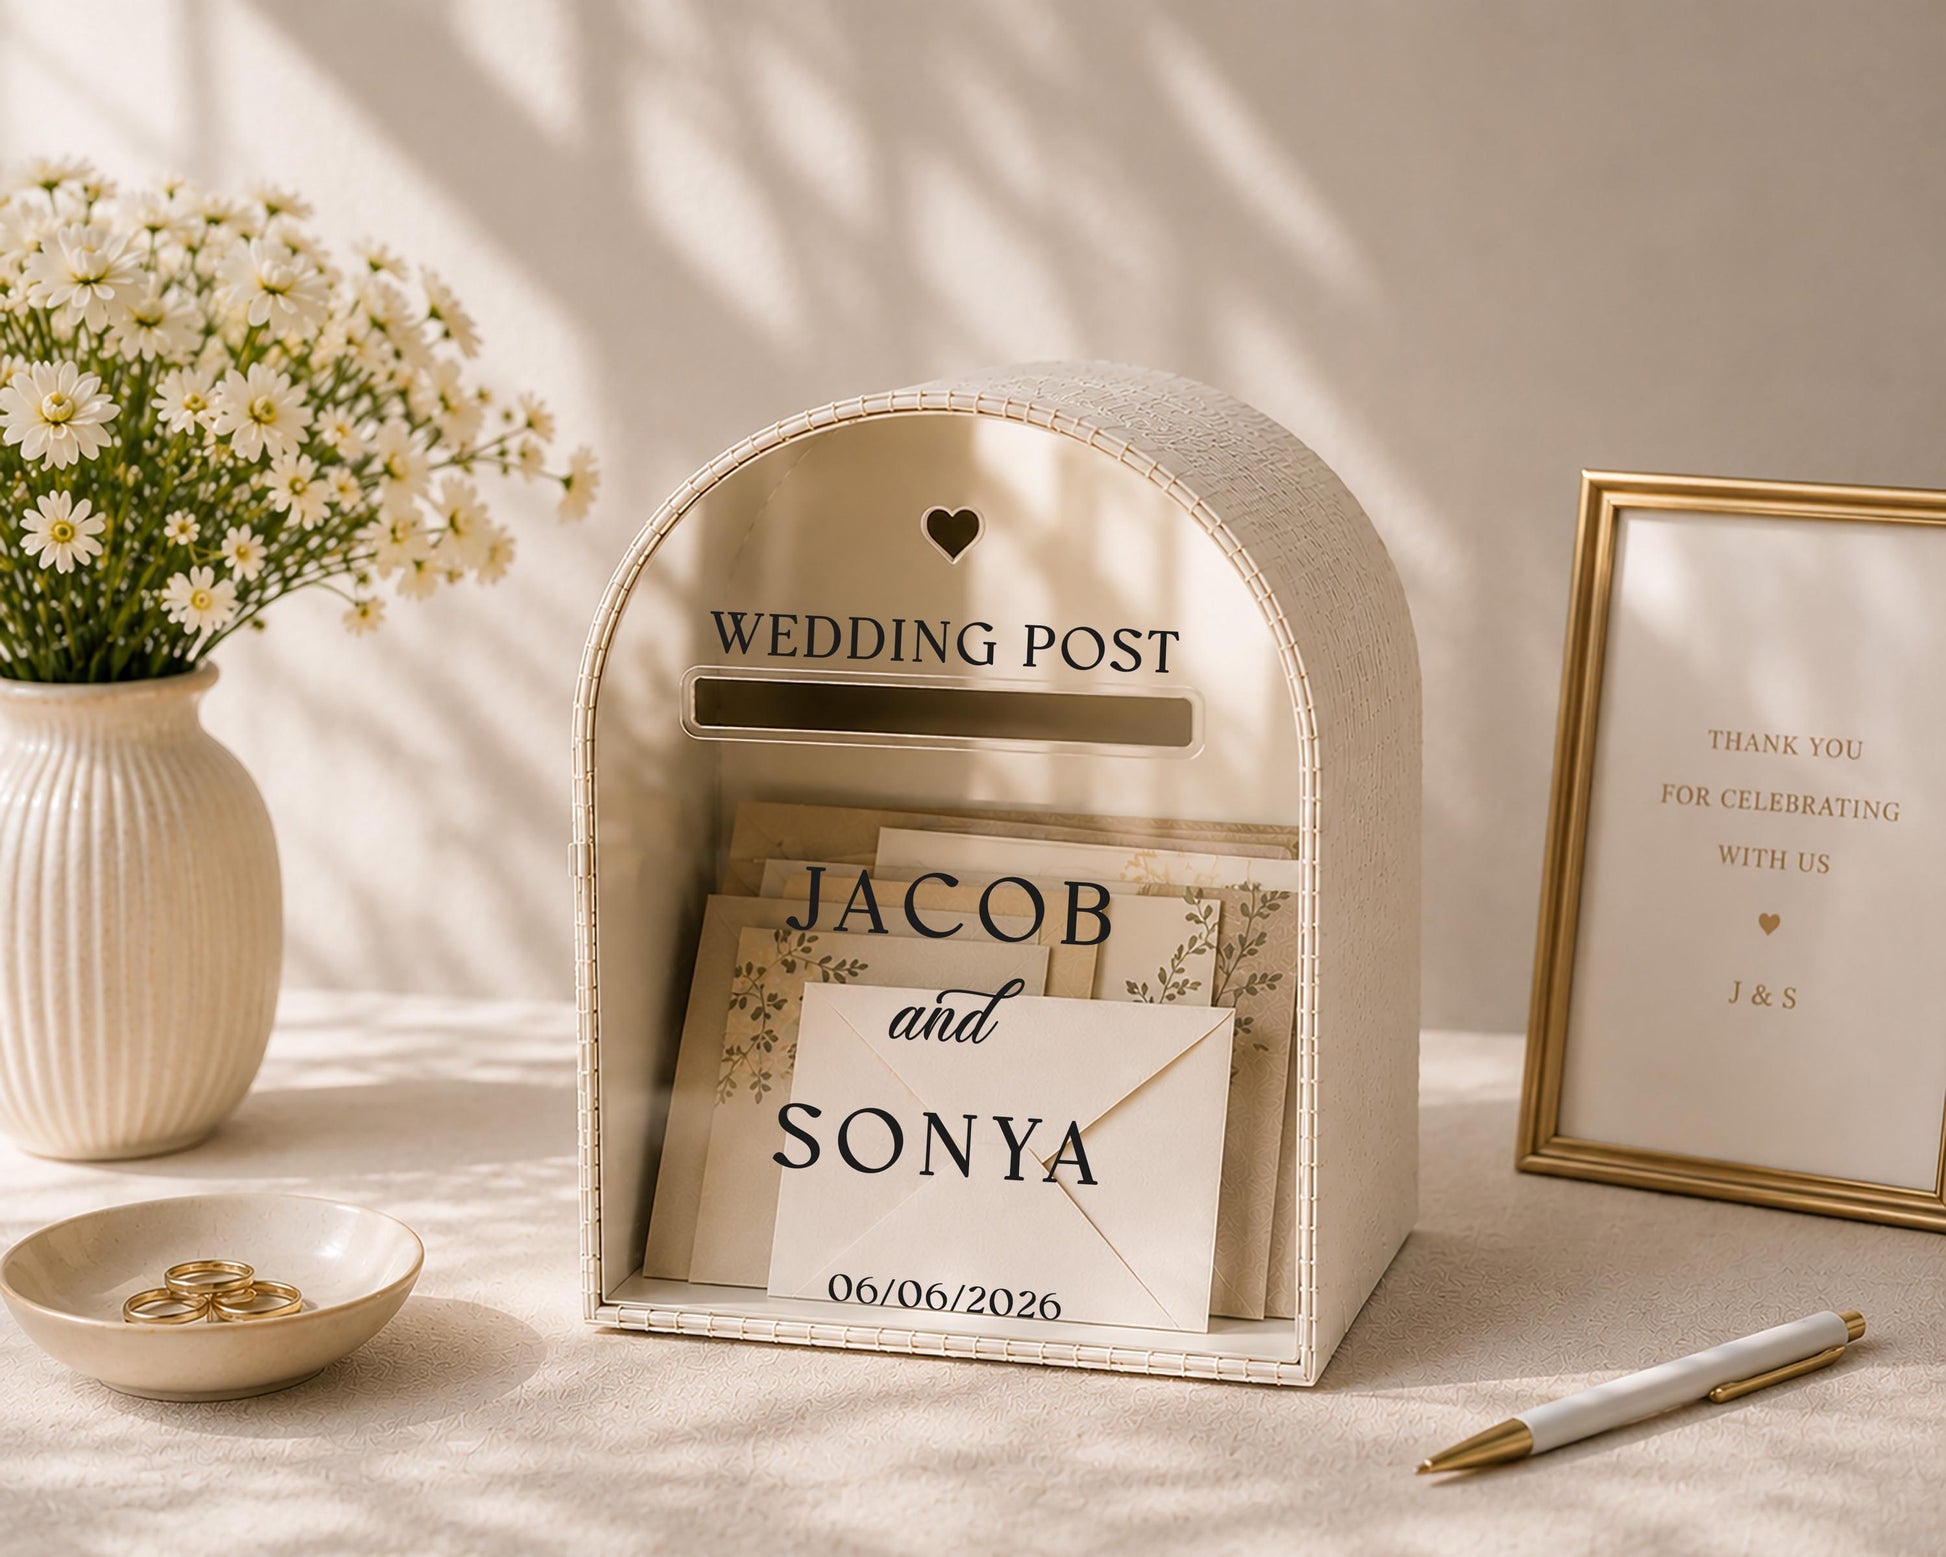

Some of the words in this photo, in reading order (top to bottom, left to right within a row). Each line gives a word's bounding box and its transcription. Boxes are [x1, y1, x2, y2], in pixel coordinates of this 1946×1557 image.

[710, 610, 997, 666] WEDDING
[1022, 624, 1180, 673] POST
[1707, 729, 1798, 755] THANK
[1809, 736, 1863, 761] YOU
[1661, 783, 1711, 807] FOR
[1719, 788, 1899, 822] CELEBRATING
[1718, 844, 1787, 871] WITH
[1798, 851, 1830, 874] US
[785, 865, 1112, 946] JACOB
[888, 978, 1026, 1045] and
[1728, 980, 1742, 1005] J
[1750, 984, 1772, 1007] &
[1781, 986, 1797, 1010] S
[772, 1102, 1098, 1186] SONYA
[828, 1273, 1061, 1321] 06/06/2026
